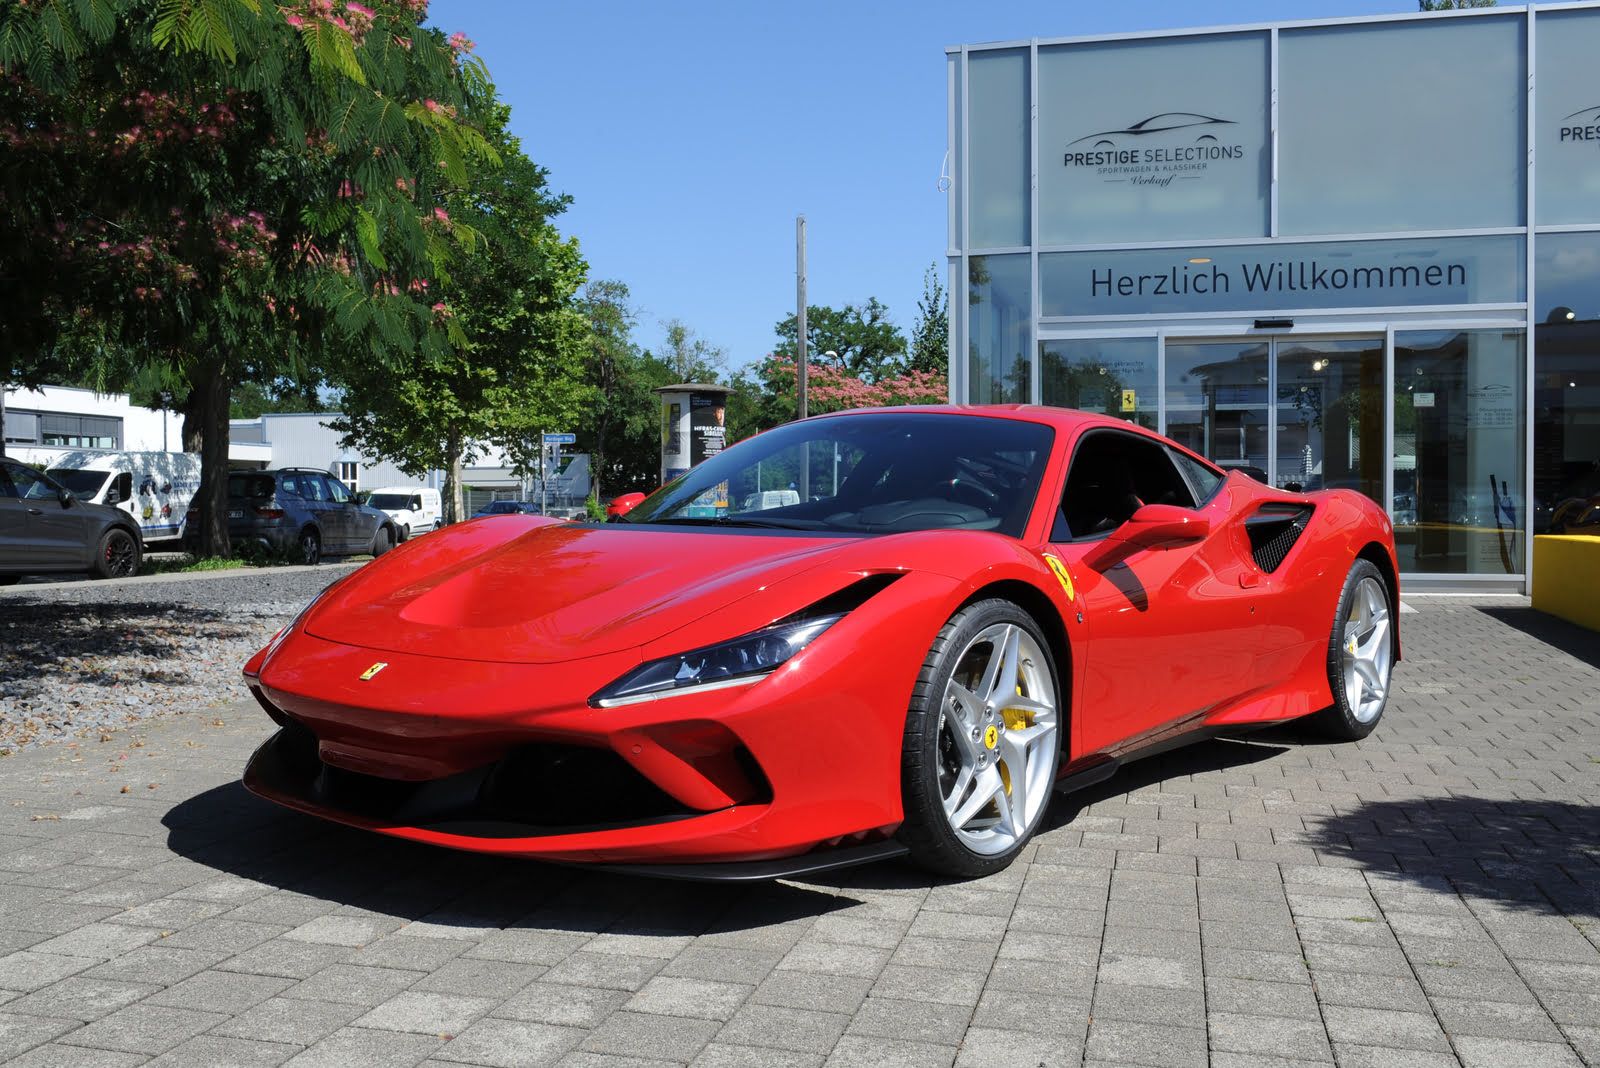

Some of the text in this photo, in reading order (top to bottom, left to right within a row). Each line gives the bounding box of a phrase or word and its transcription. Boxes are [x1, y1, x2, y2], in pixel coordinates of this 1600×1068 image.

[1064, 145, 1243, 167] PRESTIGE SELECTIONS
[1163, 162, 1208, 172] KLASSIKER
[1130, 174, 1176, 187] Verkauf
[1091, 261, 1467, 297] Herzlich Willkommen
